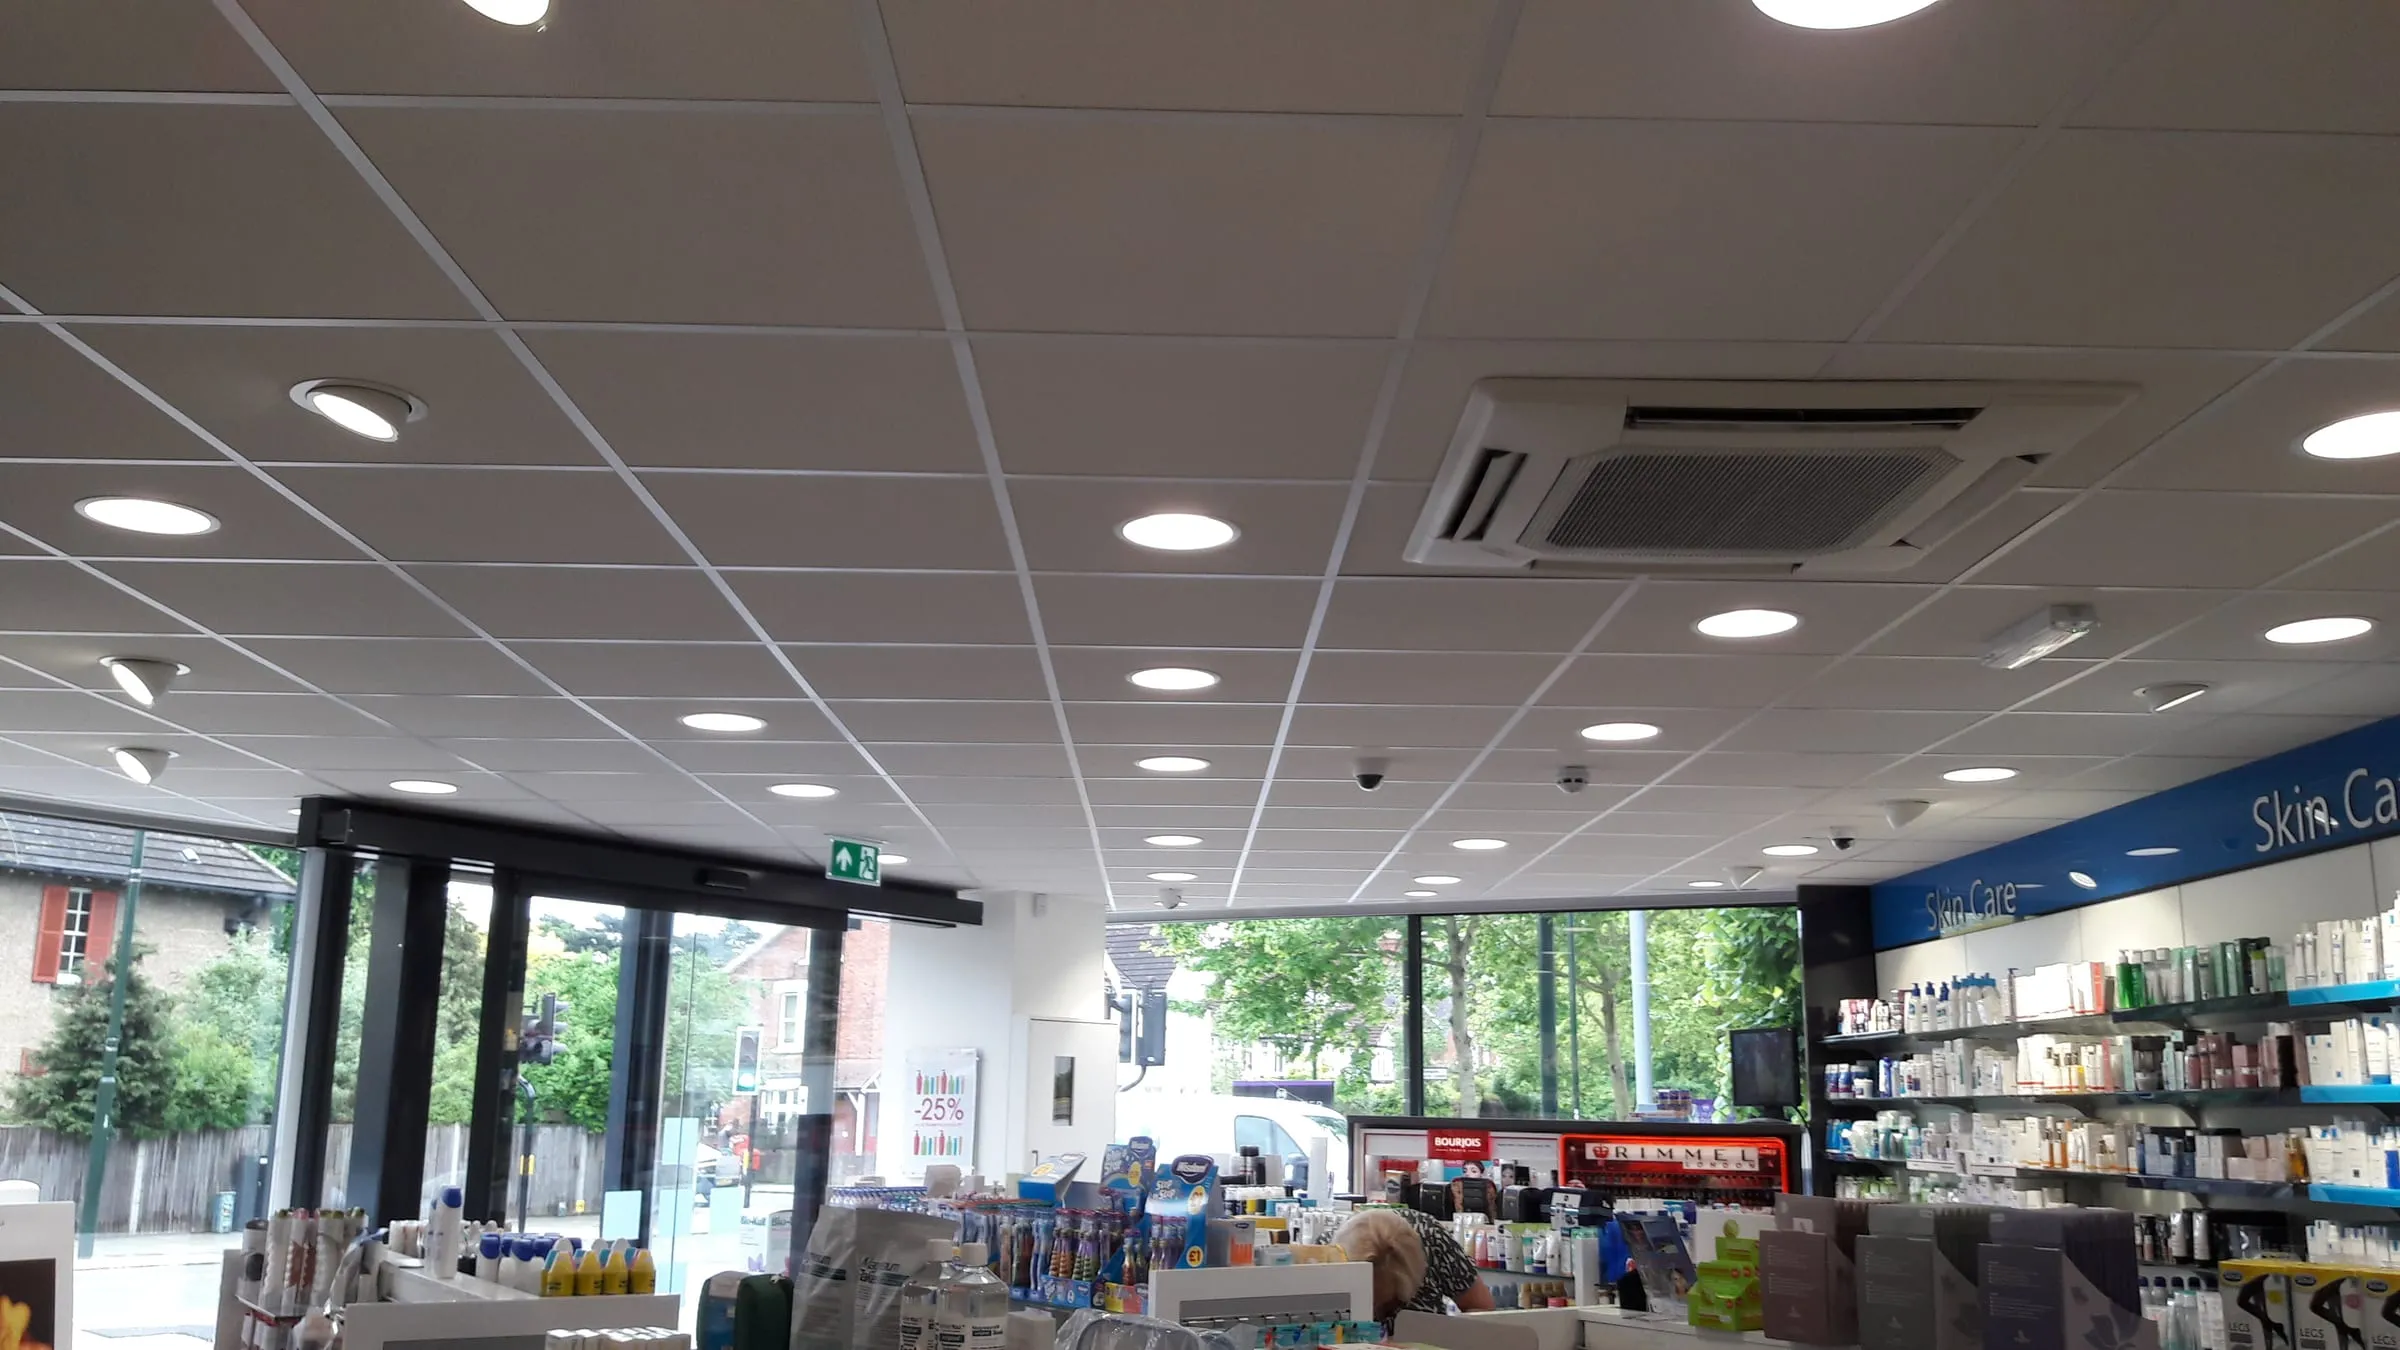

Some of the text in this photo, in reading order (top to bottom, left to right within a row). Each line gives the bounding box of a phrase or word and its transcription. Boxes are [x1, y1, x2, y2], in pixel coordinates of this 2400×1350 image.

[2253, 768, 2400, 852] Skin Ca
[1926, 879, 2016, 931] Skin Care
[914, 1097, 964, 1120] -25%
[1434, 1136, 1481, 1148] BOURJOIS
[1615, 1145, 1755, 1162] RIMMEL
[1188, 1250, 1201, 1262] £1
[2300, 1327, 2325, 1339] LEGS
